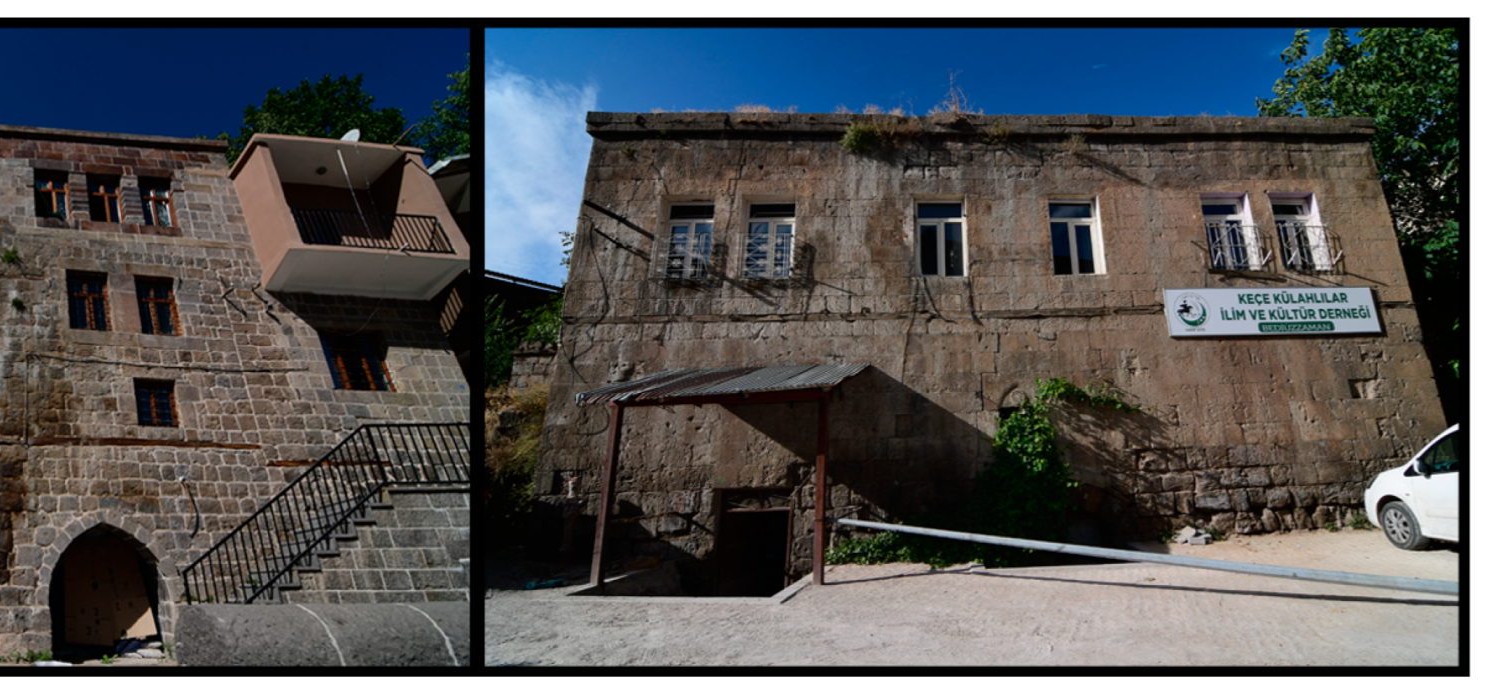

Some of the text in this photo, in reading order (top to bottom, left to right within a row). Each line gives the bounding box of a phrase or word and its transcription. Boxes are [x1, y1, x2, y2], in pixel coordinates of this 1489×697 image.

[1238, 291, 1348, 305] KEÇE KÜLAHLILAR
[1220, 305, 1371, 320] İLİM VE KÜLTÜR DERNEĞİ
